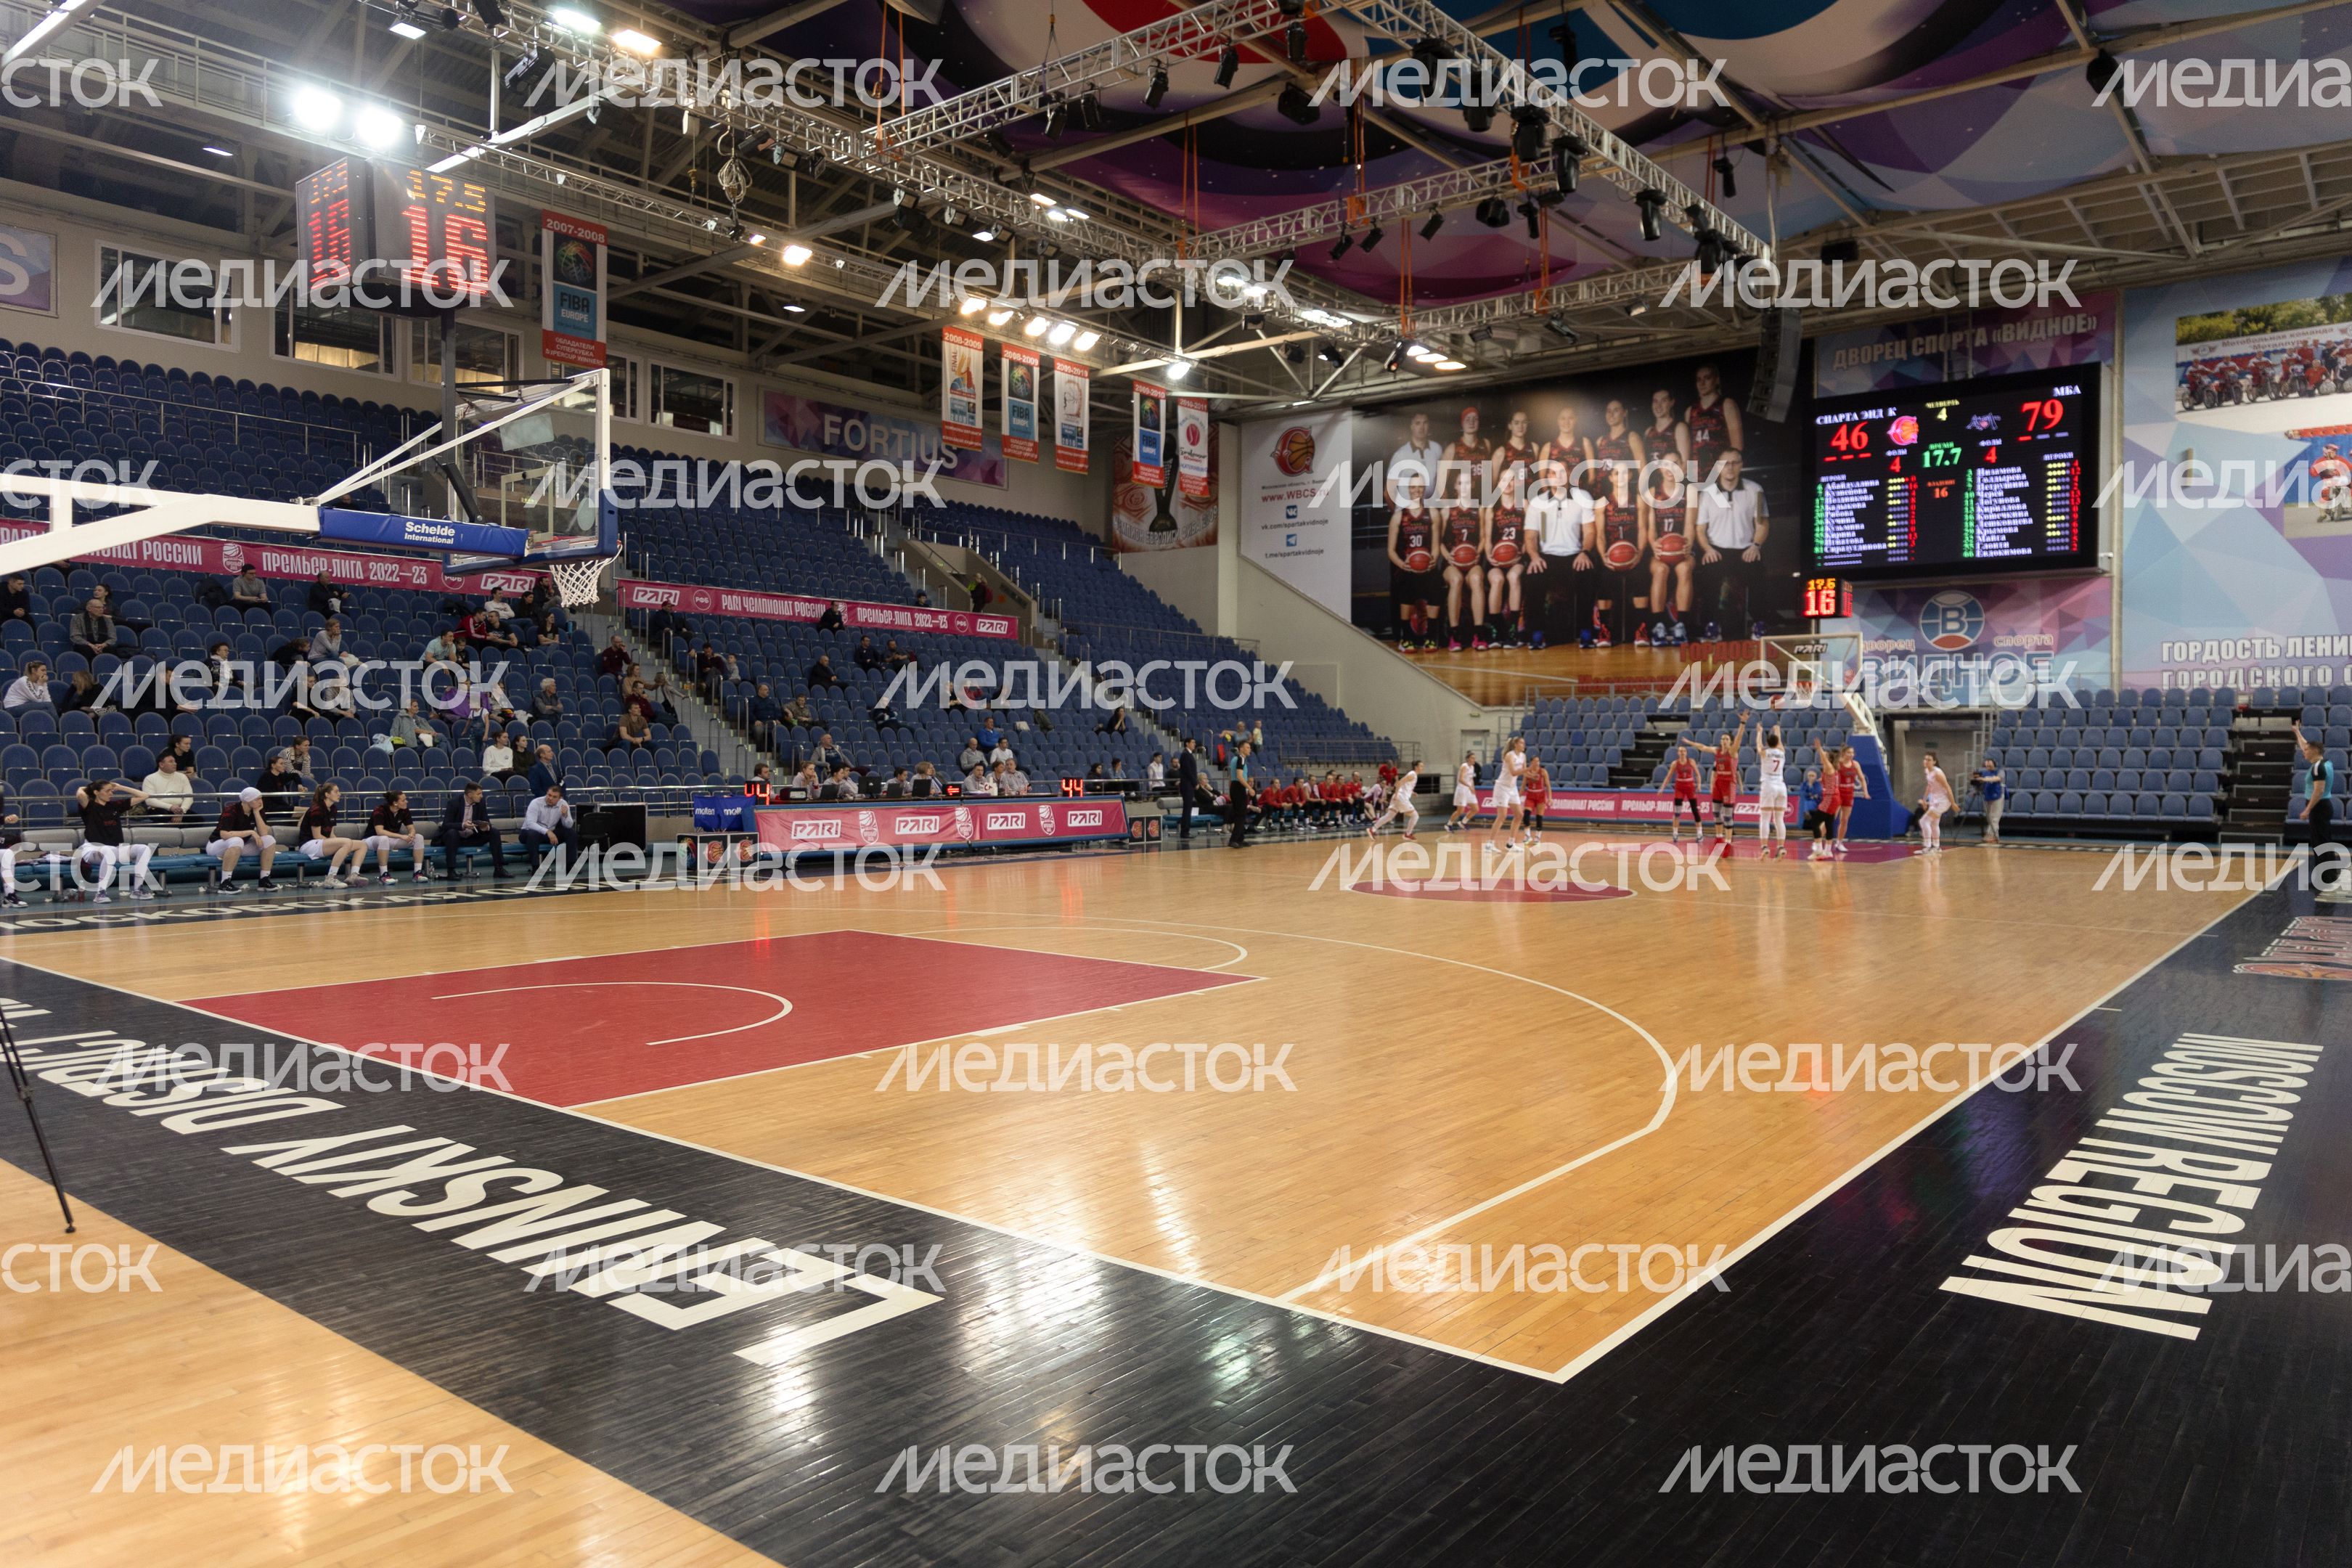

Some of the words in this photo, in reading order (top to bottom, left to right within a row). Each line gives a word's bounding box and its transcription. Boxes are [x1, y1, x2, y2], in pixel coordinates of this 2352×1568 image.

[547, 219, 605, 243] 2007-2008
[401, 204, 489, 295] 16
[560, 292, 591, 314] FIBA
[560, 309, 589, 324] EUROPE
[944, 332, 982, 350] 2008-2009
[1833, 340, 1908, 371] ДВОРЕЦ
[1911, 327, 1988, 357] СПОРТА
[1992, 312, 2097, 344] «ВИДНОЕ»
[1012, 404, 1030, 420] FIBA
[1936, 407, 1948, 421] 4
[2021, 399, 2065, 432] 79
[823, 414, 959, 469] FORTIUS
[1695, 429, 1711, 442] 44
[1829, 420, 1869, 452] 46
[1890, 455, 1902, 473] 4
[1922, 446, 1962, 468] 17.7
[1983, 446, 1997, 464] 4
[1935, 487, 1949, 499] 16
[405, 520, 456, 536] Schelde
[1501, 526, 1516, 541] 23
[1663, 518, 1675, 532] 17
[404, 533, 454, 545] International
[1409, 534, 1423, 548] 30
[1461, 528, 1469, 542] 7
[143, 539, 203, 565] РОССИИ
[722, 594, 741, 611] PARI
[743, 597, 793, 616] ЧЕМПИОНАТ
[1804, 589, 1836, 617] 16
[977, 619, 1008, 634] PARI
[1993, 633, 2054, 649] спорта
[2161, 637, 2282, 665] ГОРДОСТЬ
[2161, 663, 2334, 691] ГОРОДСКОГО
[1772, 759, 1781, 773] 7
[1061, 778, 1084, 798] 44
[695, 807, 715, 815] molten
[1068, 810, 1103, 826] PARI
[792, 820, 841, 838] PARI
[896, 816, 940, 834] PARI
[987, 812, 1026, 830] PARI
[2095, 1032, 2324, 1156] MOSCOW
[220, 1123, 945, 1368] LENINSKIY
[1938, 1137, 2273, 1342] REGION
